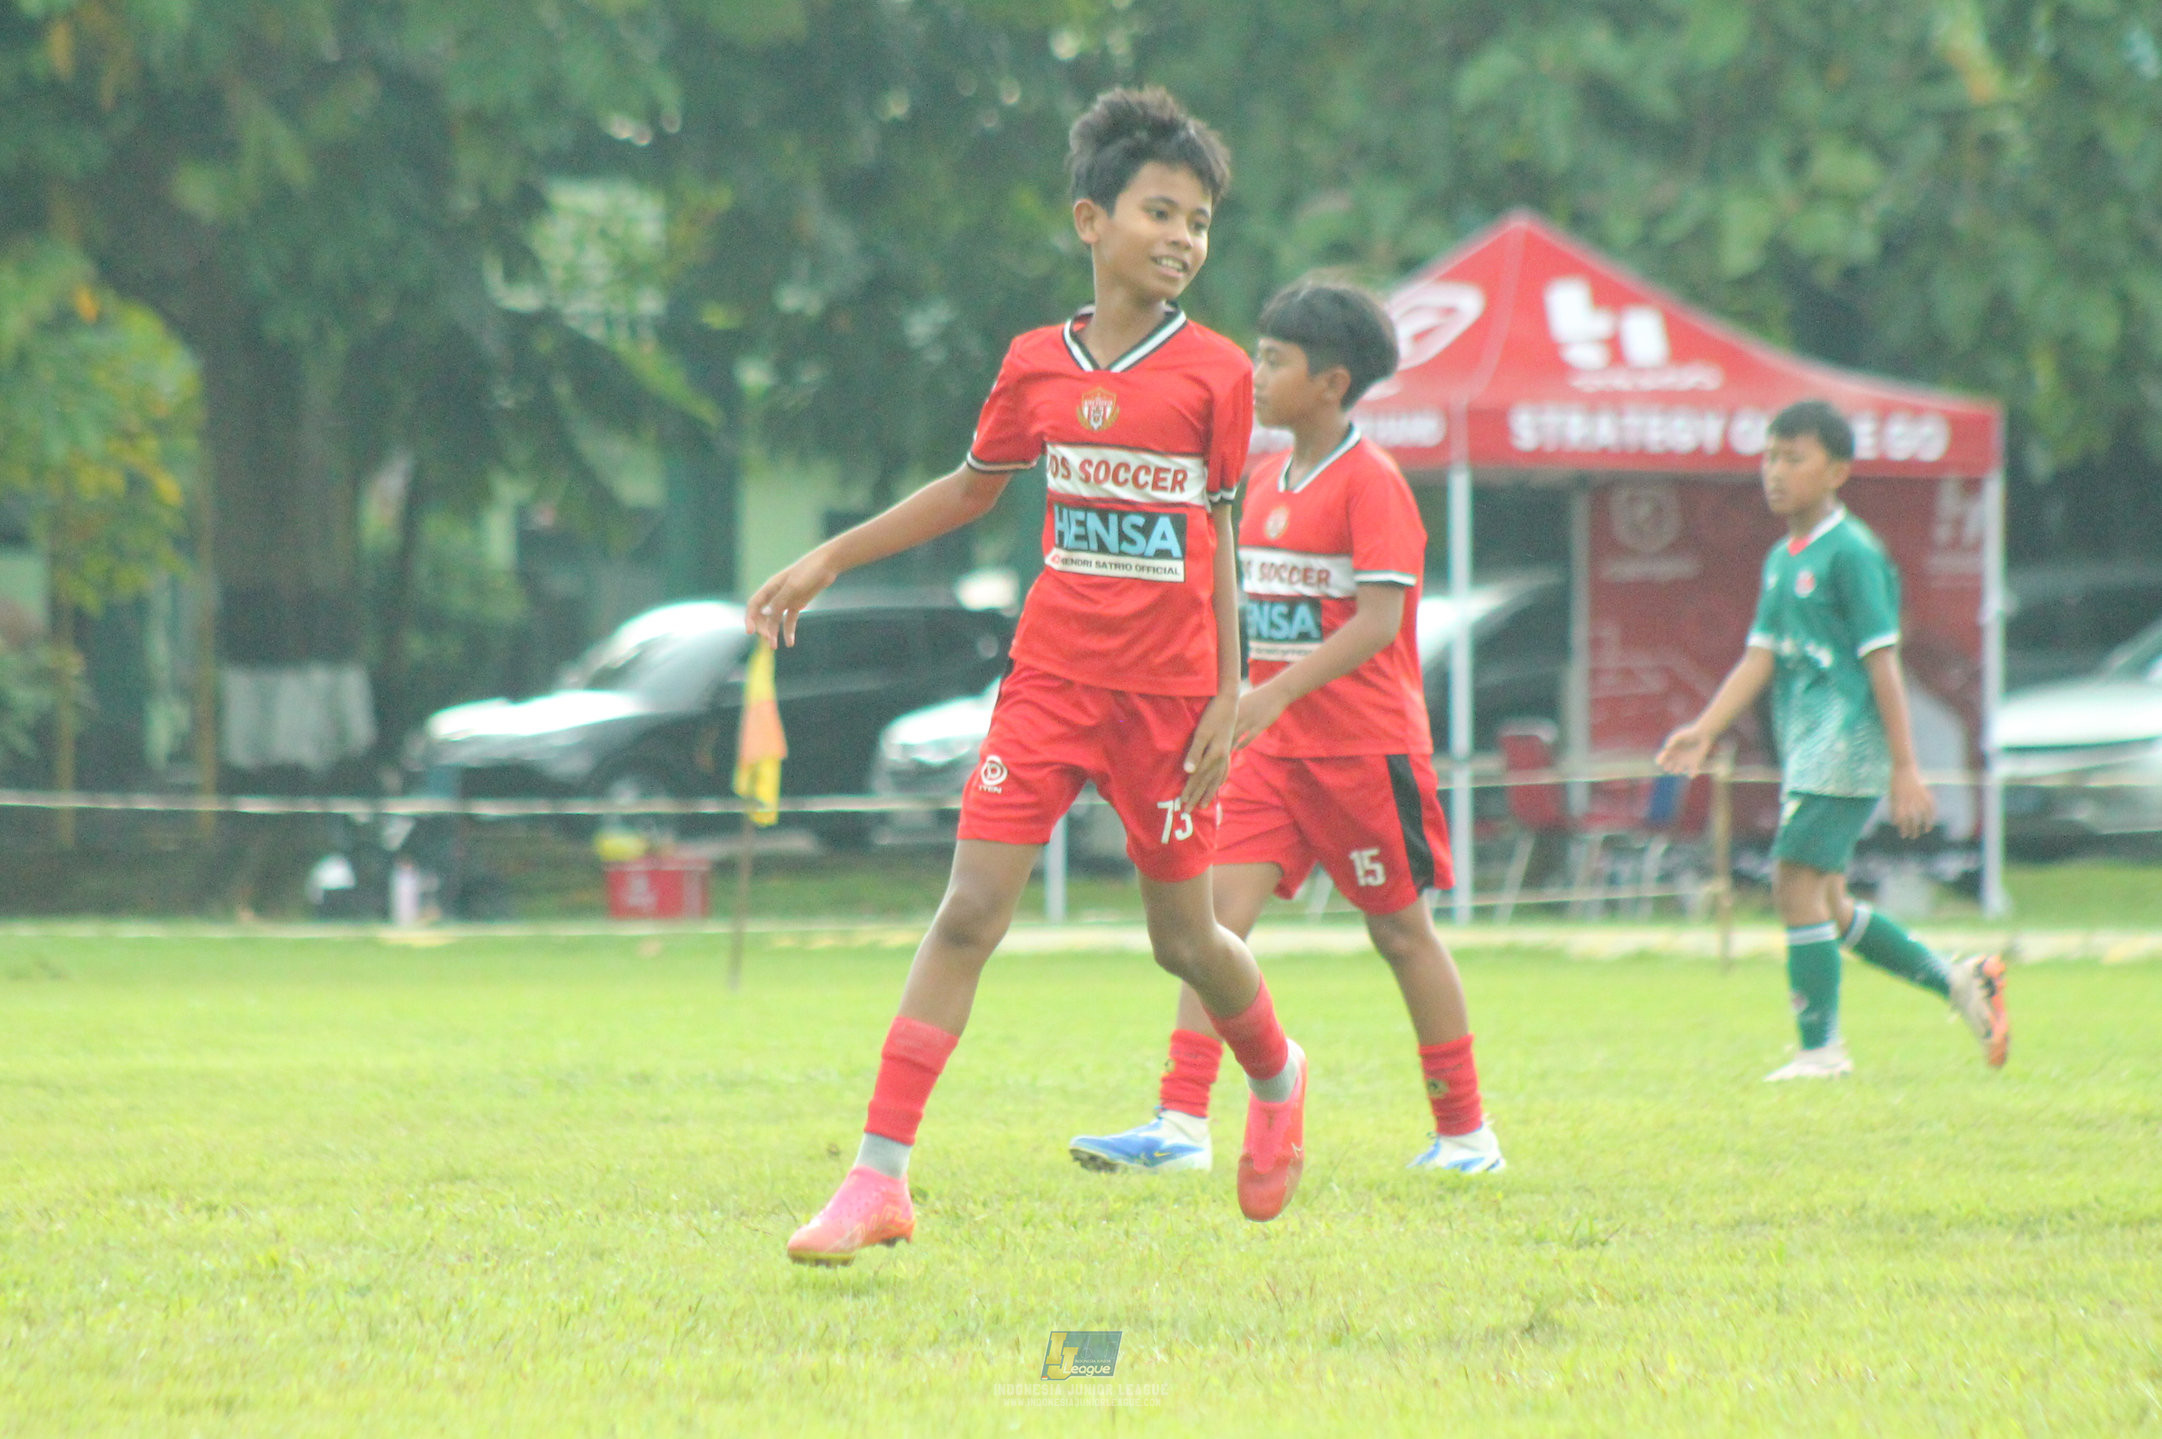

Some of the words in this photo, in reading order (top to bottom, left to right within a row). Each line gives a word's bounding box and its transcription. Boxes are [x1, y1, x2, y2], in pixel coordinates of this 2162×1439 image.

[1508, 403, 1725, 455] STRATEGY
[1079, 459, 1188, 493] SOCCER
[1054, 505, 1183, 558] HENSA
[1095, 560, 1132, 571] SATRIO
[1135, 563, 1180, 575] OFFICIAL
[1259, 562, 1330, 587] SOCCER
[1157, 797, 1194, 844] 73
[1349, 848, 1387, 887] 15
